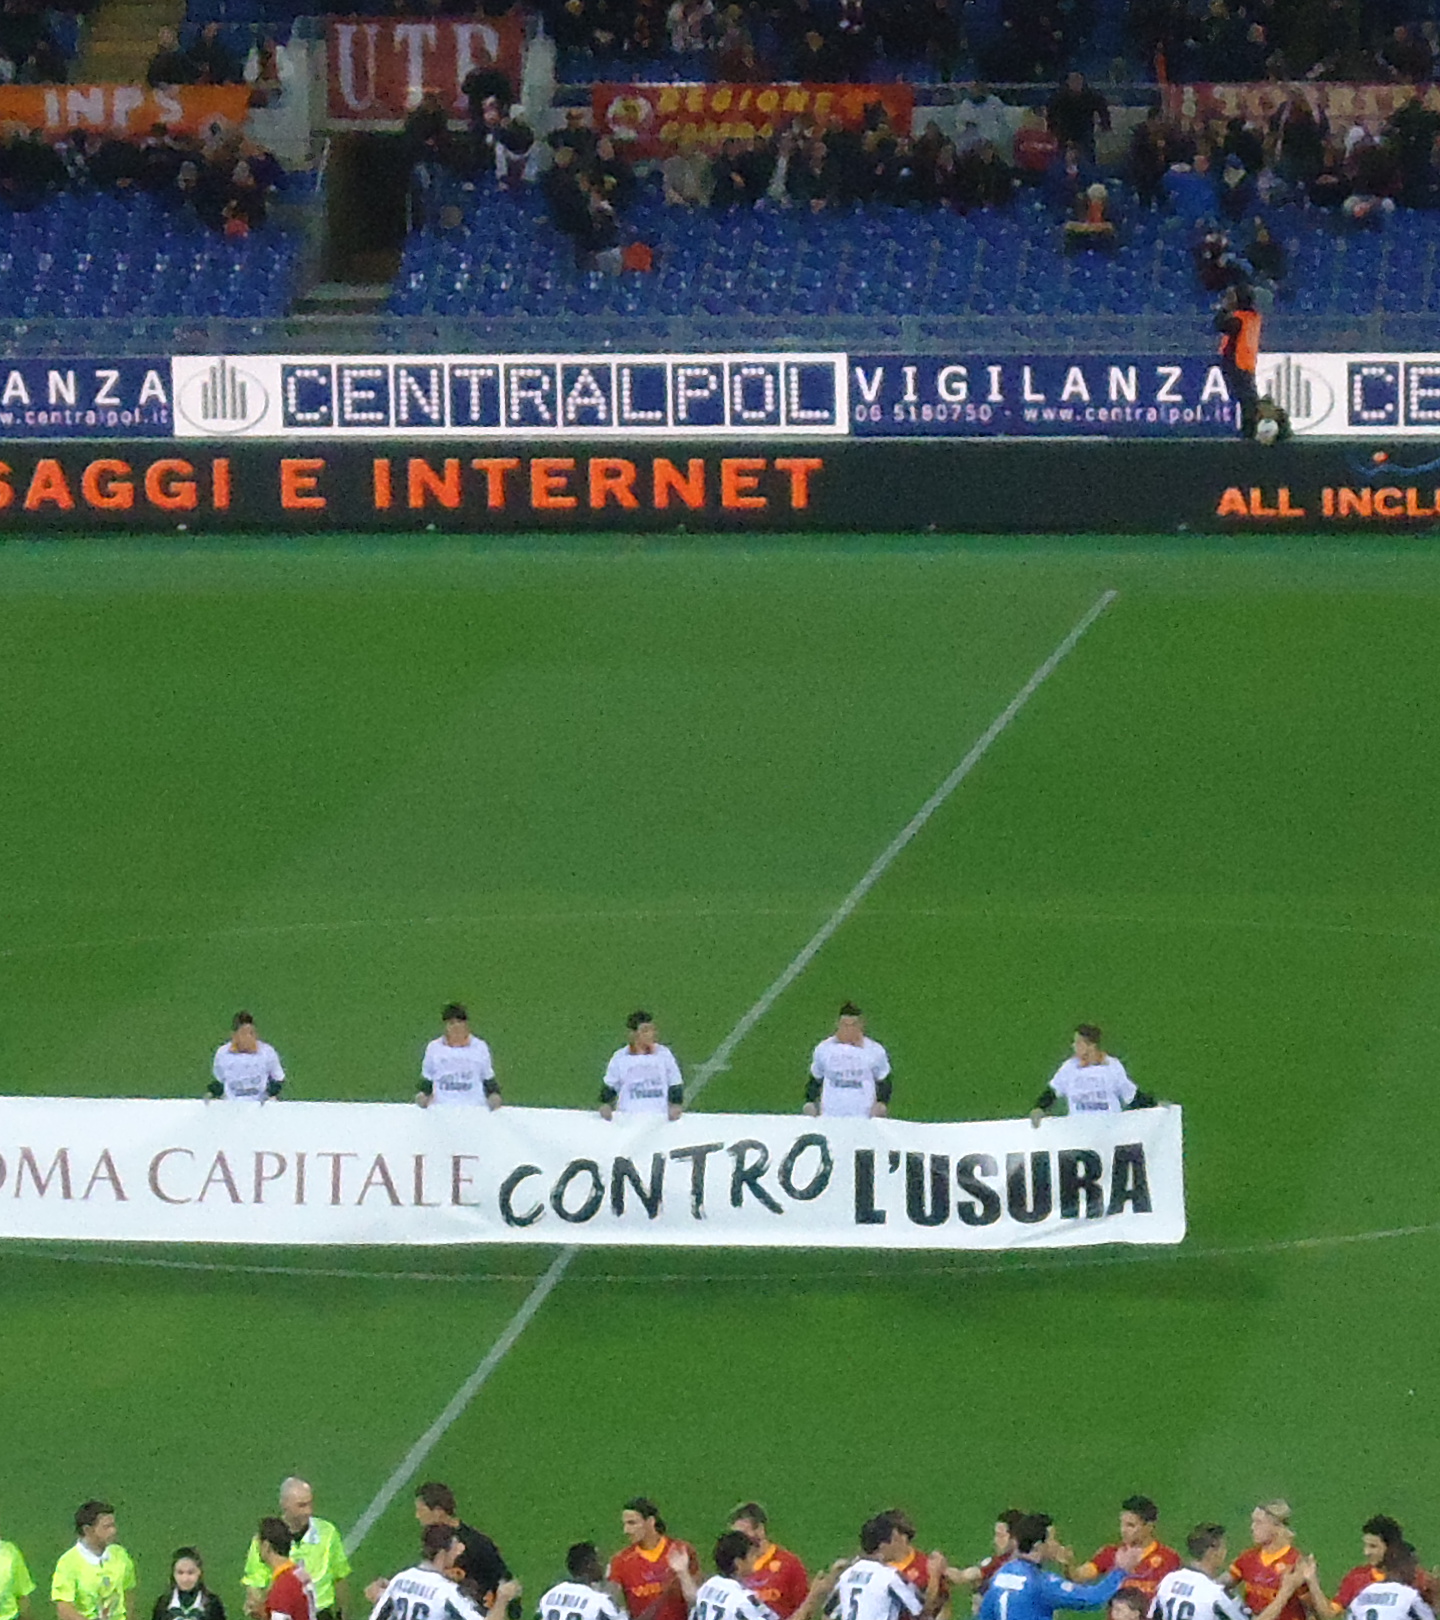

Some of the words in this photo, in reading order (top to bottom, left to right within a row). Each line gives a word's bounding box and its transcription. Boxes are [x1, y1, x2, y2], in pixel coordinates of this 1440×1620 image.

[284, 366, 832, 423] CENTRALPOL
[853, 365, 1232, 402] VIGILANZA
[280, 457, 328, 511] E
[371, 456, 826, 511] INTERNET
[1216, 486, 1304, 518] ALL
[147, 1147, 482, 1209] CAPITALE
[498, 1132, 835, 1228] CONTRO
[853, 1142, 1154, 1227] L'USURA
